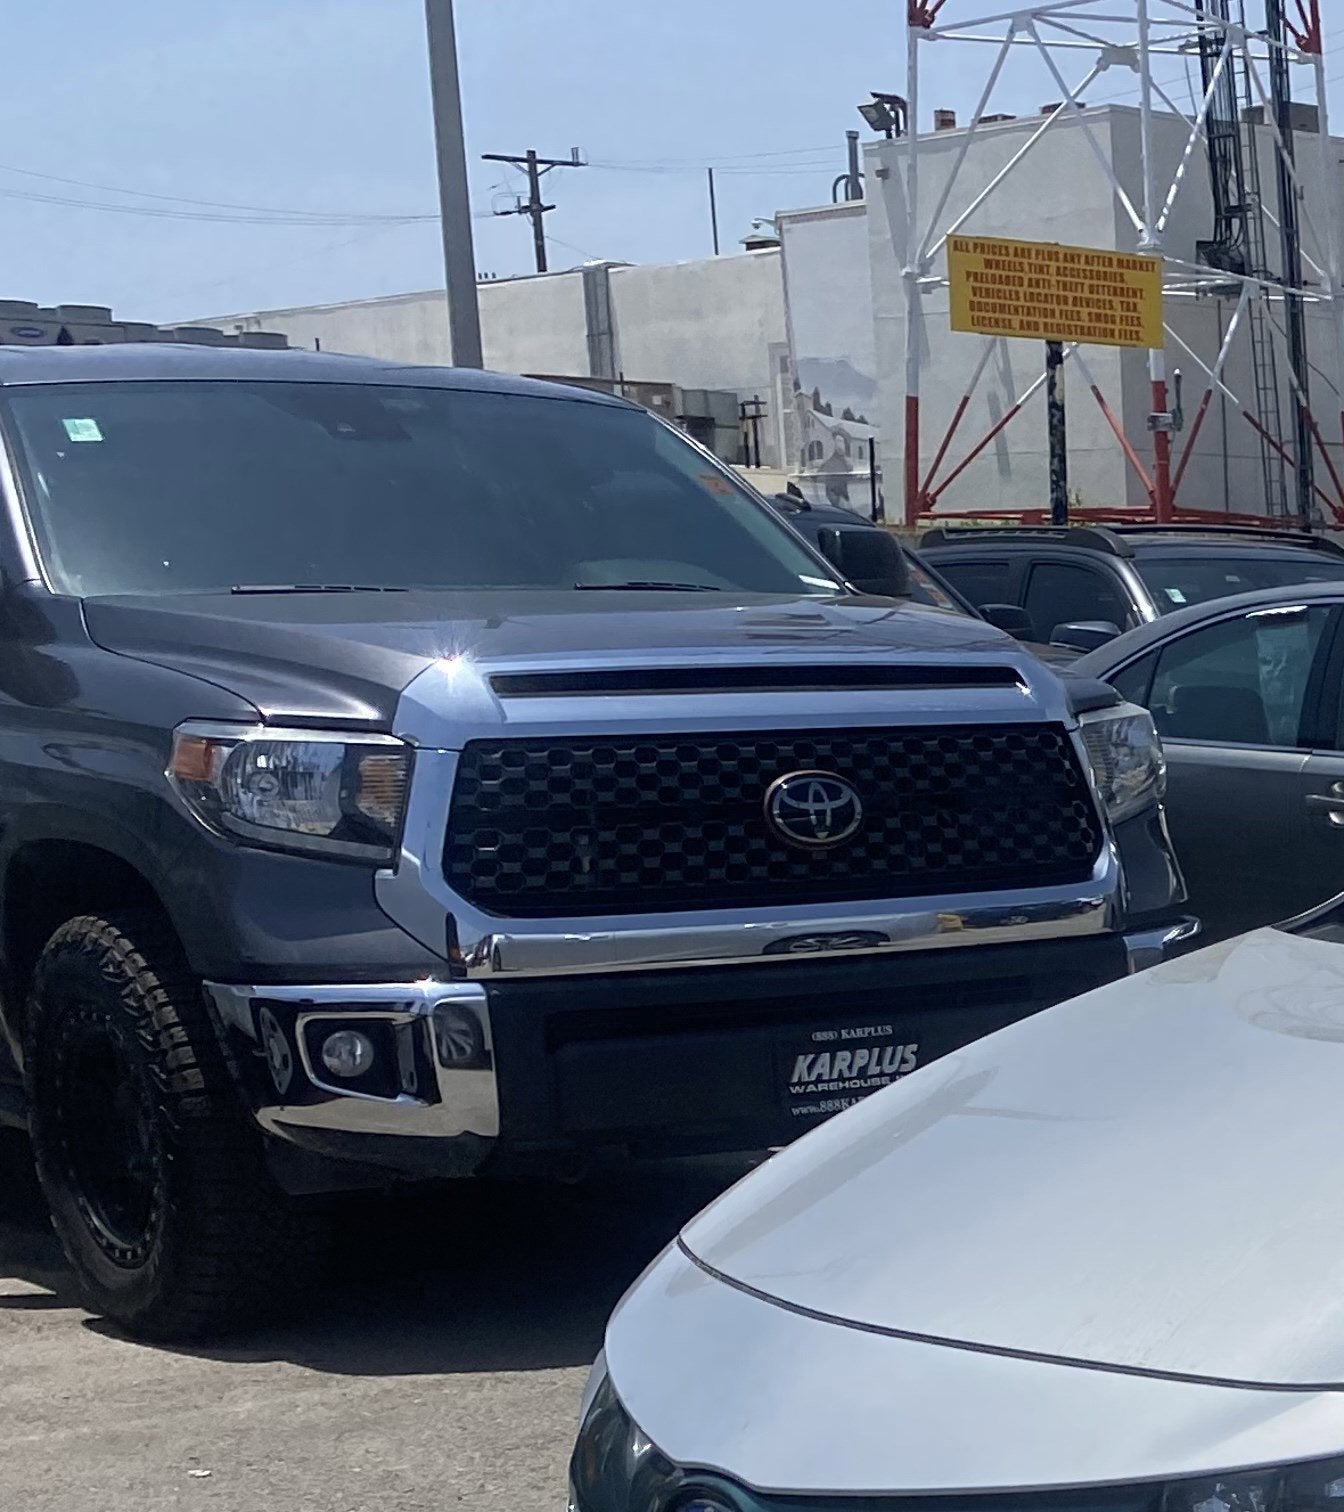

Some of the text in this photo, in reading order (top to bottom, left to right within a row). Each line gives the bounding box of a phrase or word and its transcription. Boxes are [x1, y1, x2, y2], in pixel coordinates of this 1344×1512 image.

[953, 240, 1155, 272] ALL PRICES ARE PLUS ANY AFTER MARKET
[966, 271, 1023, 287] PRELOADED
[1027, 277, 1084, 293] ANTI-THEFT
[972, 286, 1020, 301] VEHICLES
[1023, 291, 1068, 305] LOCATOR
[969, 301, 1055, 318] DOCUMENTATION
[1088, 312, 1116, 324] SMOG
[1019, 320, 1038, 331] AND
[1043, 322, 1114, 338] REGISTRATION
[841, 1025, 893, 1040] KARPLUS
[791, 1044, 918, 1083] KARPLUS
[789, 1077, 891, 1094] WAREHOUSE
